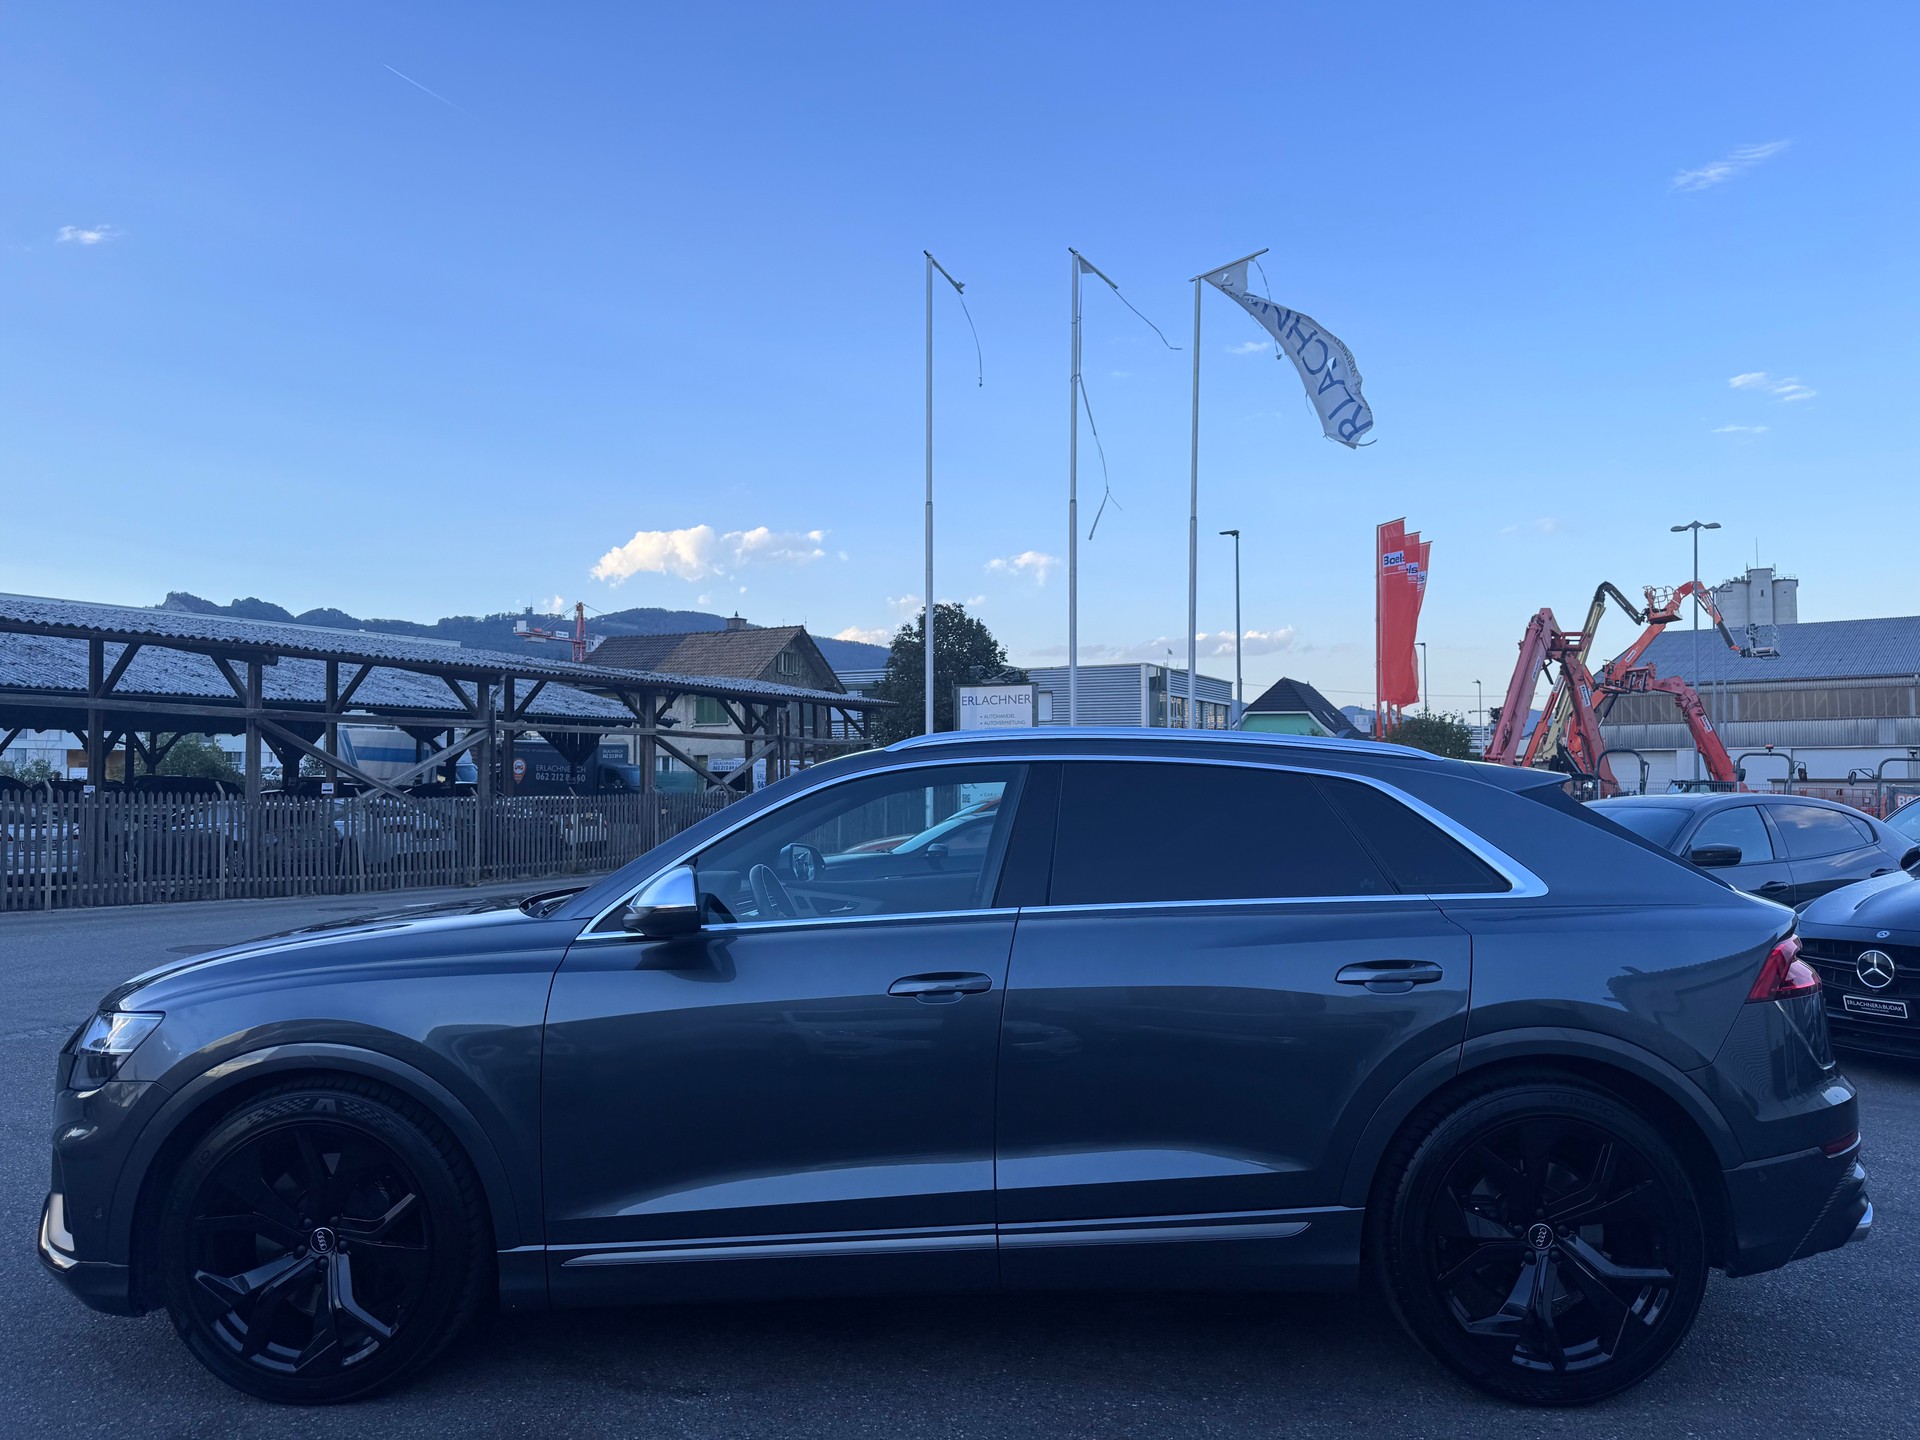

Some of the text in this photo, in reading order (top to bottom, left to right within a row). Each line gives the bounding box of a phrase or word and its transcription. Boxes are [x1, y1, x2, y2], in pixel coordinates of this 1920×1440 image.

[961, 693, 1032, 706] ERLACHNER
[535, 772, 549, 781] 062
[551, 772, 564, 781] 212
